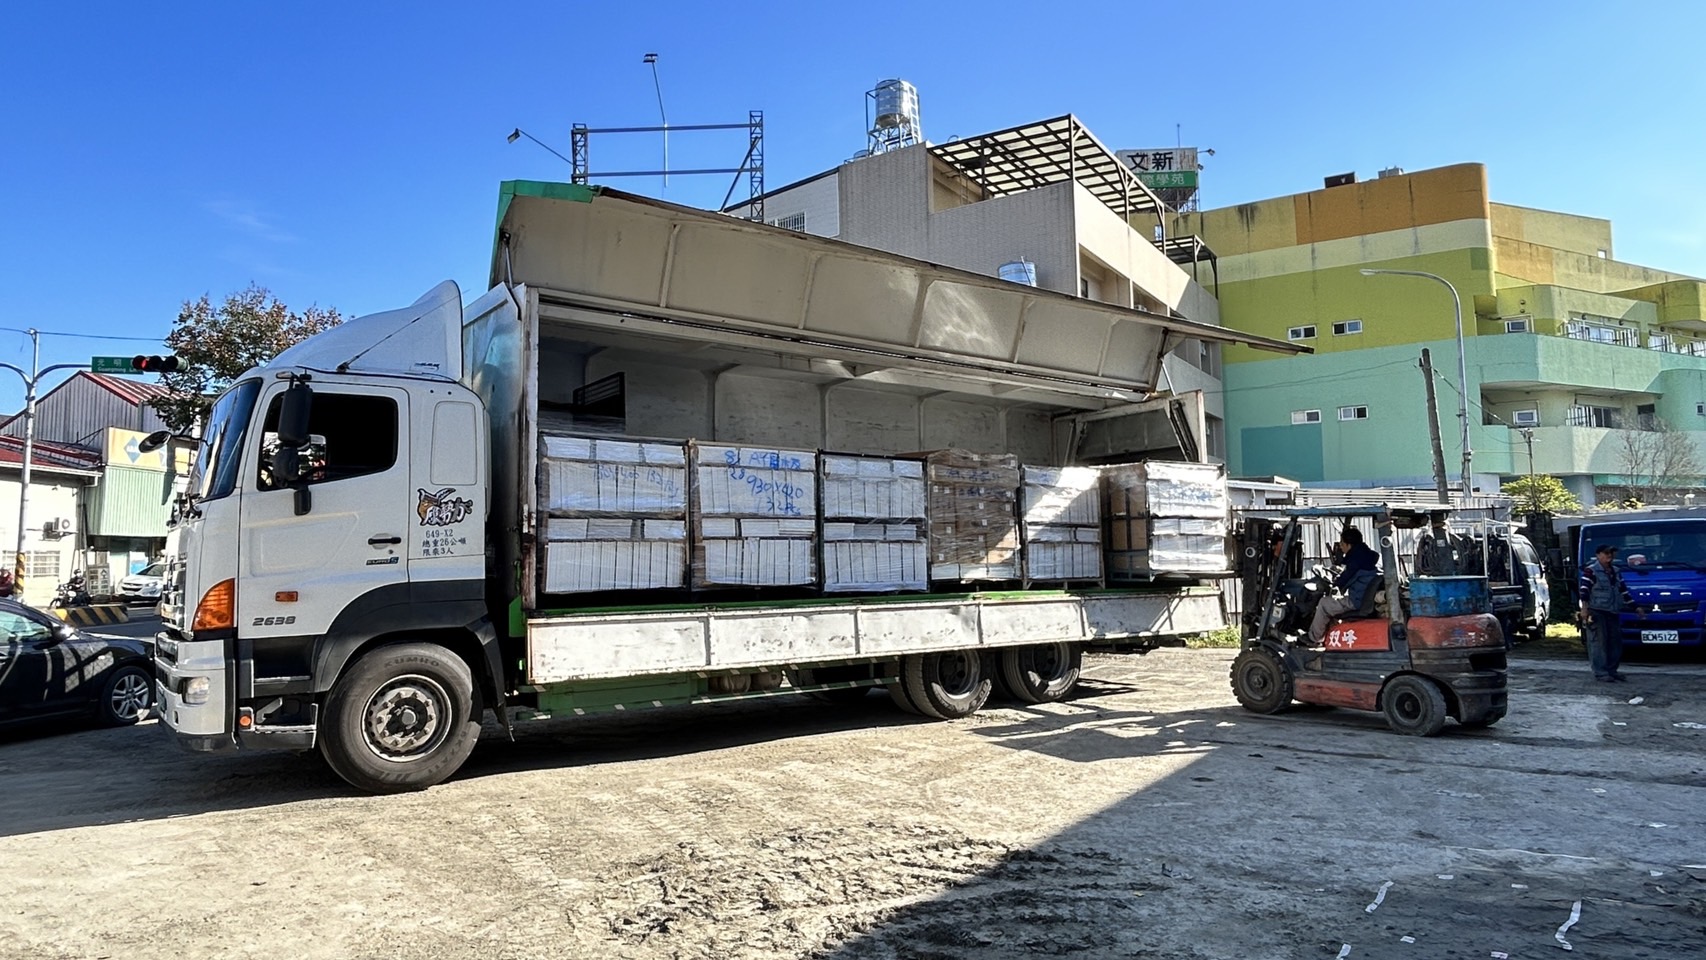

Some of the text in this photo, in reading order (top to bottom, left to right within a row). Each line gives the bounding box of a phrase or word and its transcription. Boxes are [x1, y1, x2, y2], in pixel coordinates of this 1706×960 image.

[1127, 151, 1173, 172] 文新
[1136, 173, 1185, 187] 際學苑
[97, 358, 134, 367] 光明
[425, 528, 454, 540] 649-X2
[252, 615, 297, 626] 2638
